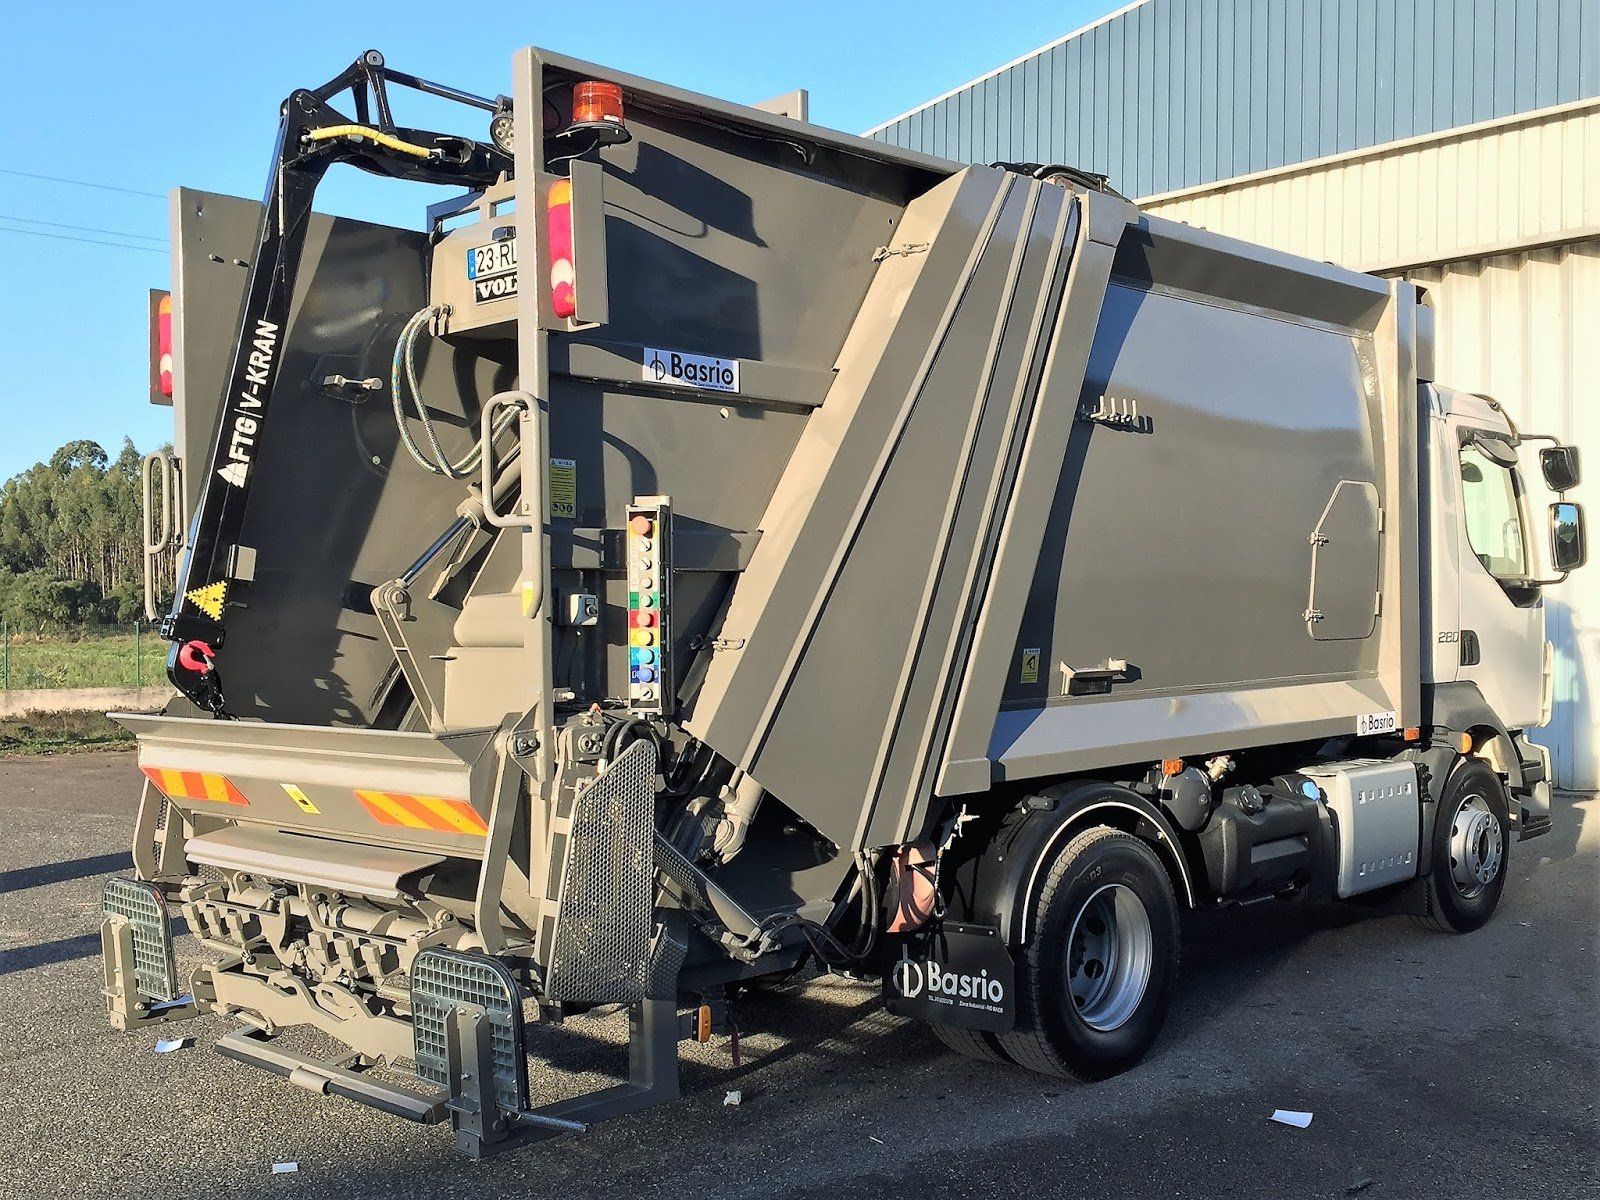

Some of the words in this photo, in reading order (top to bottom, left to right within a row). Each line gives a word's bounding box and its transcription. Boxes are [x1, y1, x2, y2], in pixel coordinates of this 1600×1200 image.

[476, 274, 518, 299] VOL
[239, 319, 279, 408] V-KRAN
[670, 352, 734, 386] Basrio
[1437, 631, 1459, 643] 280
[1368, 713, 1394, 731] Basrio
[927, 960, 1004, 1003] Basrio
